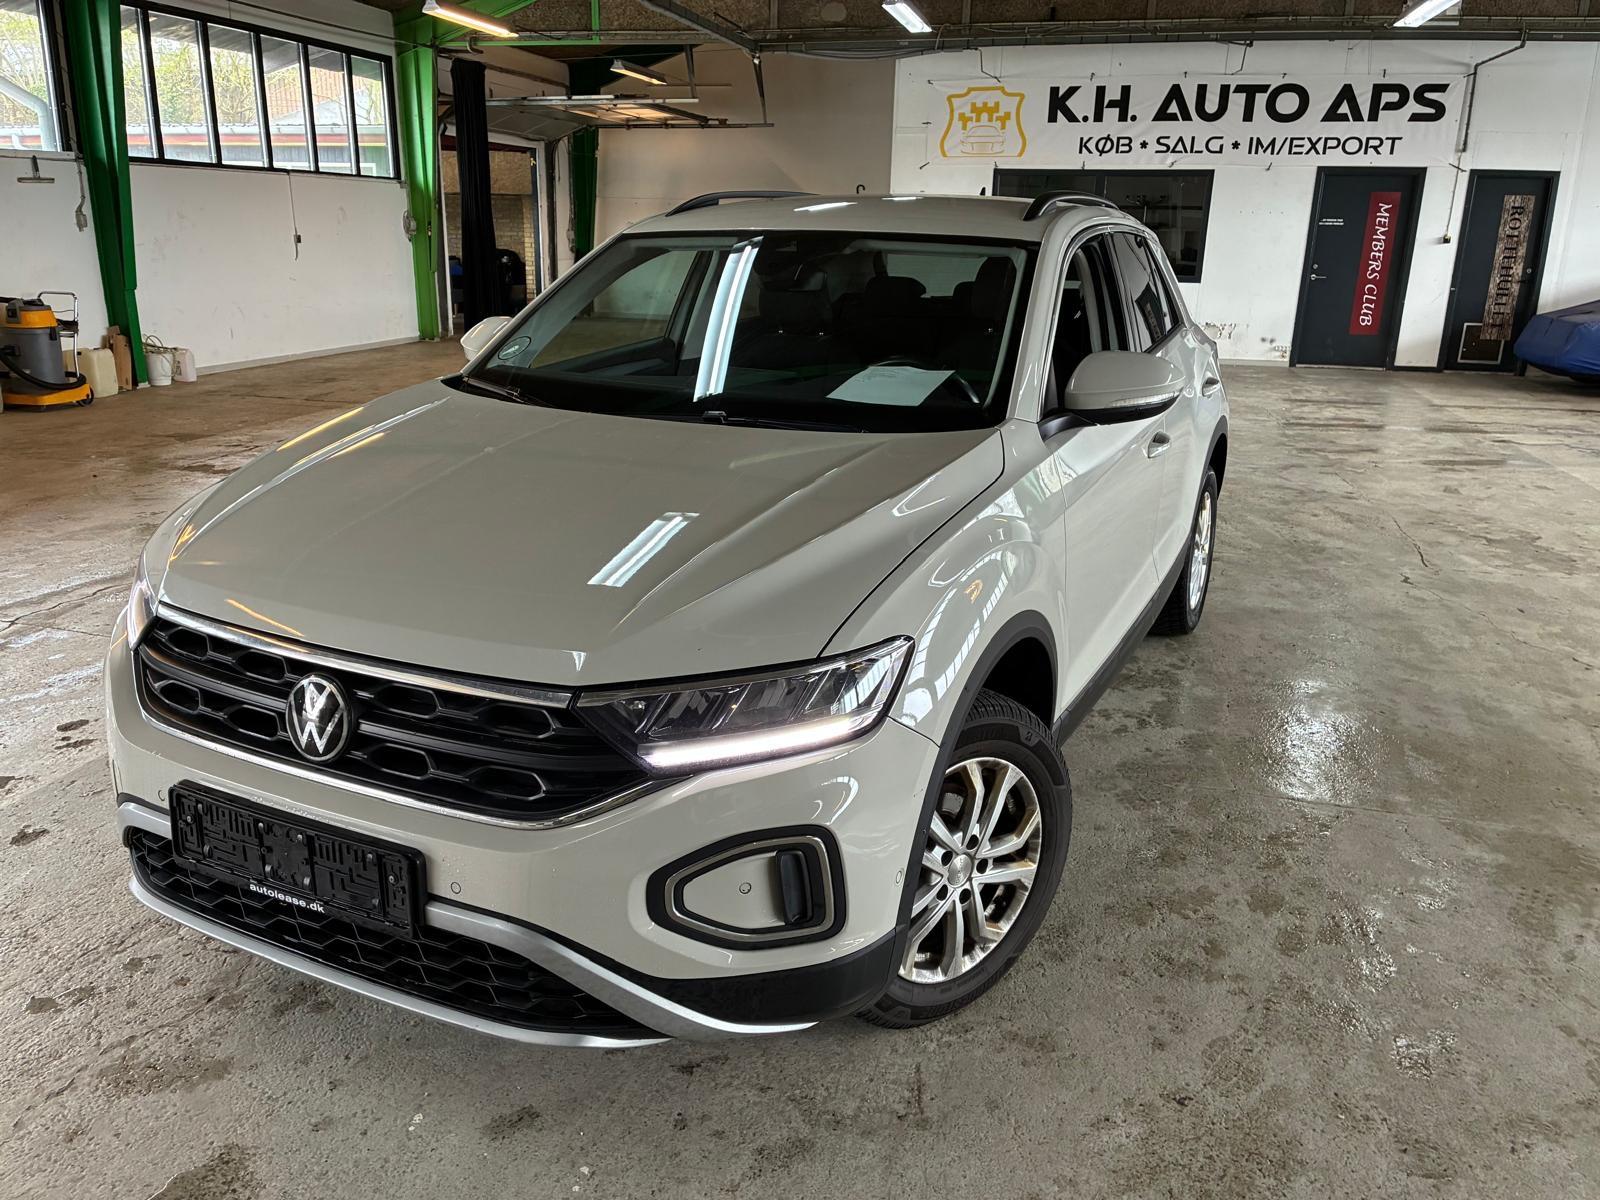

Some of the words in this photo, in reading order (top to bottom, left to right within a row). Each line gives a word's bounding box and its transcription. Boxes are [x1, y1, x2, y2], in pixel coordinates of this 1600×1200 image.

[1048, 85, 1137, 123] K.H.
[1152, 83, 1309, 123] AUTO
[1320, 83, 1450, 122] APS
[1079, 134, 1132, 156] KØB
[1155, 136, 1223, 153] SALG
[1248, 137, 1402, 155] IM/EXPORT
[1366, 202, 1393, 280] MEMBERS
[1360, 283, 1378, 326] CLUB
[249, 884, 326, 914] autolease.dk
